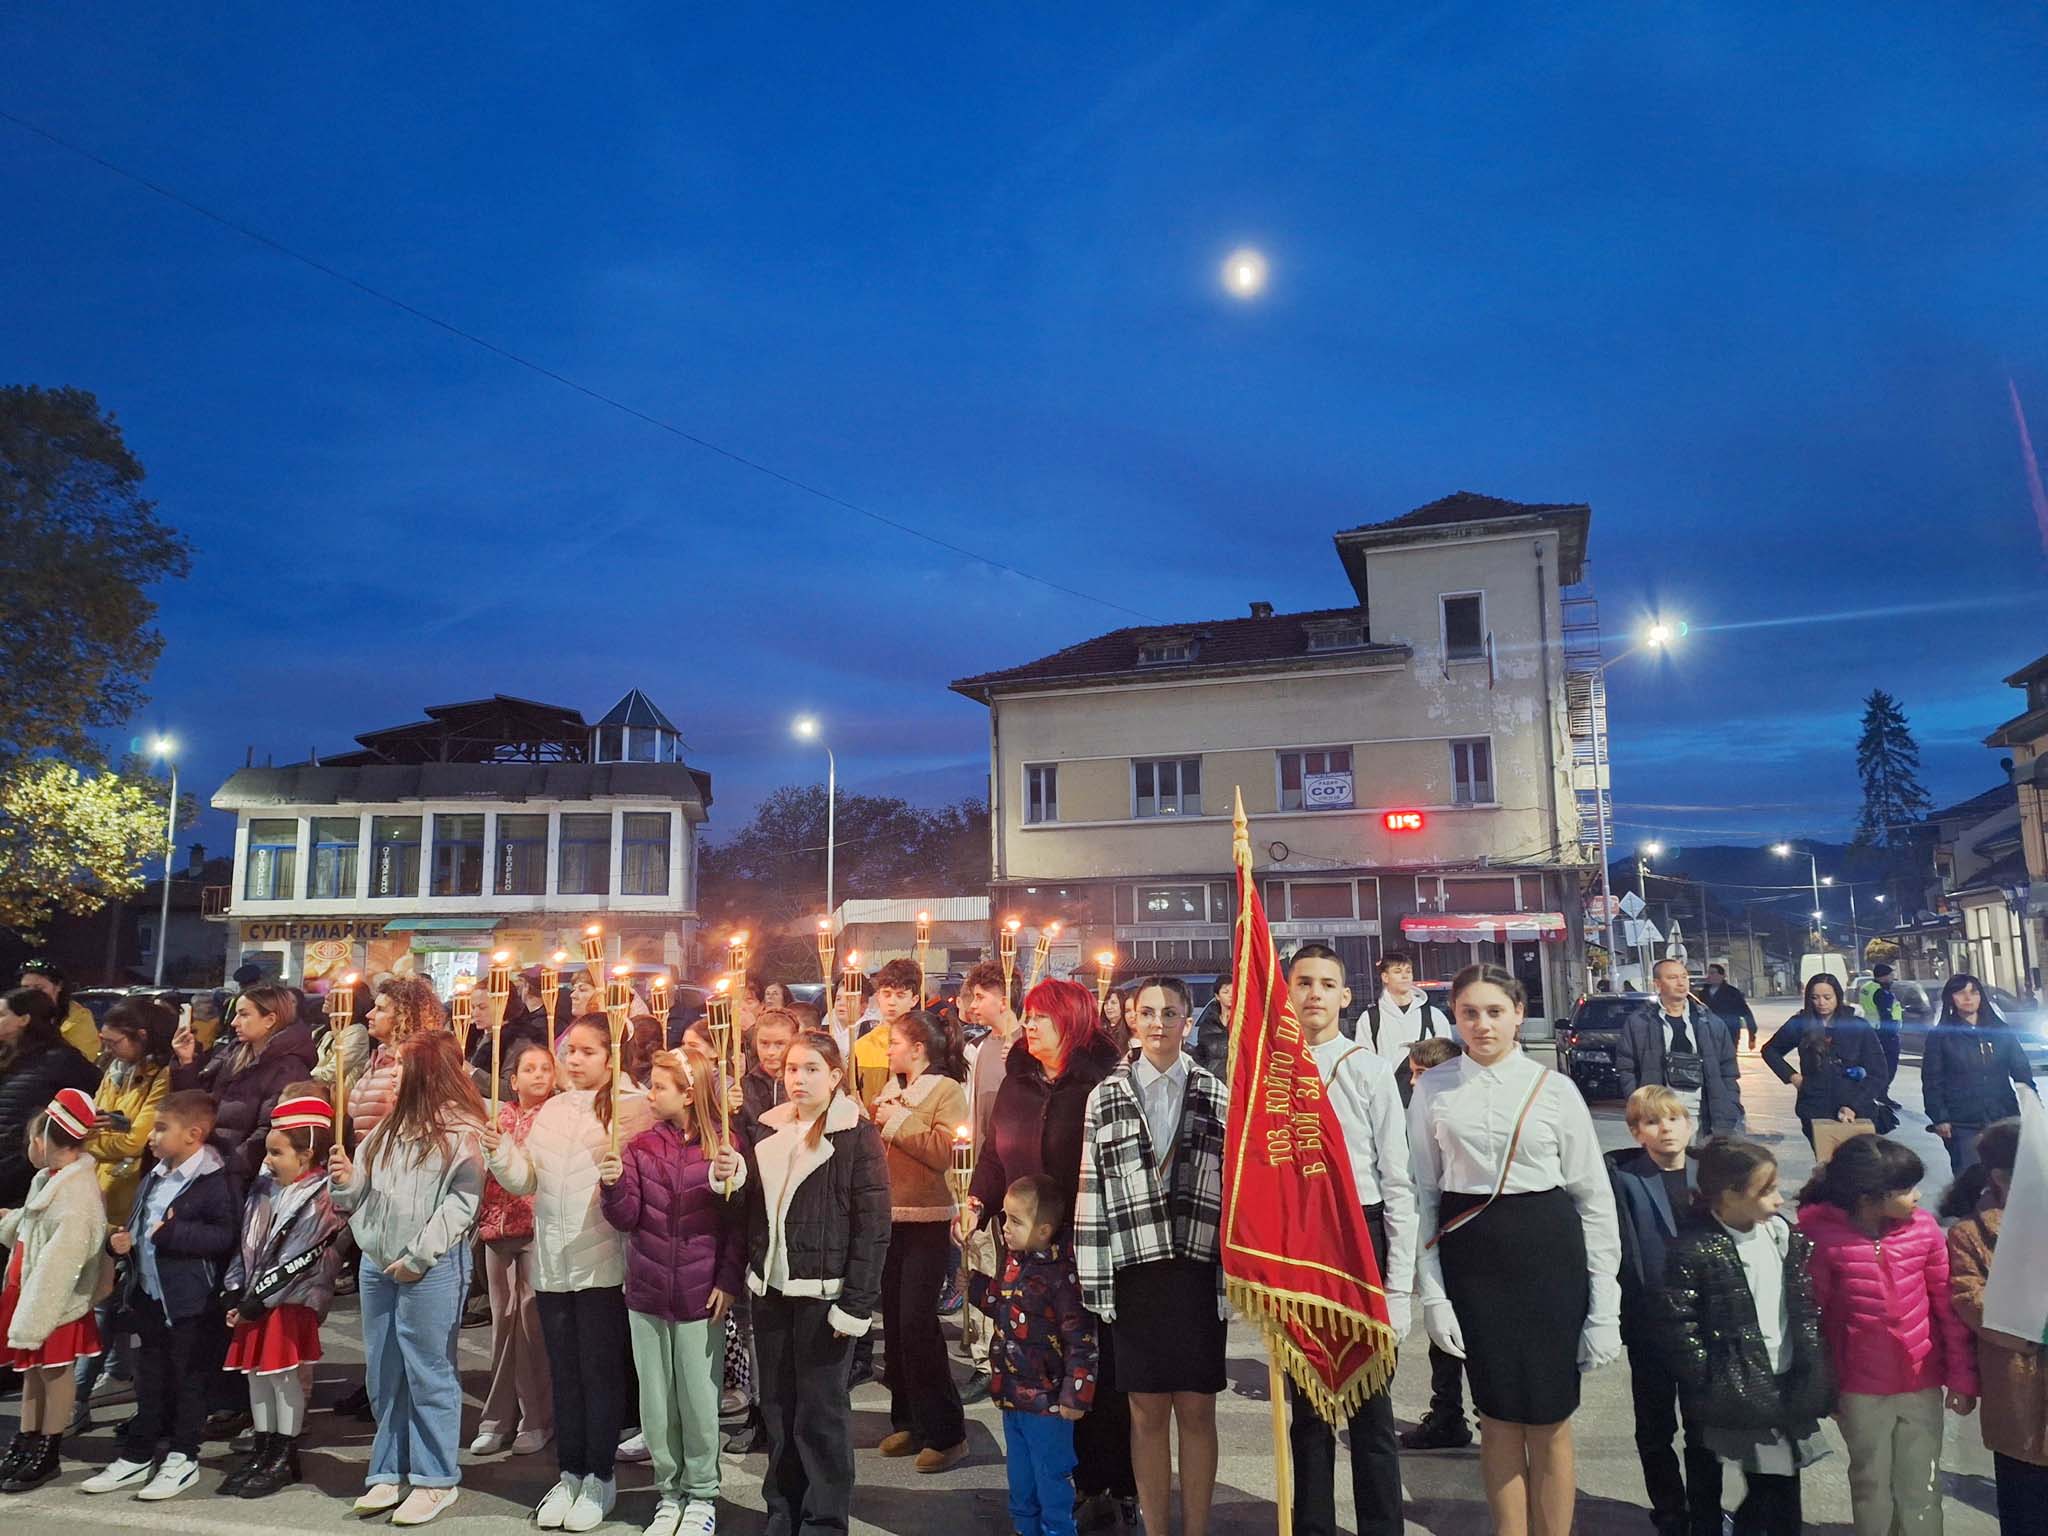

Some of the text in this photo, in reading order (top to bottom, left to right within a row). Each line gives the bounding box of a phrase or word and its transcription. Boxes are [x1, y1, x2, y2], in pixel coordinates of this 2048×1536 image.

[1311, 785, 1347, 796] СОТ
[380, 846, 390, 893] ОТВОРЕНО
[504, 843, 513, 891] ОТВОРЕНО
[1263, 1050, 1295, 1116] КОЙТО
[1296, 1075, 1321, 1101] ЗА
[1290, 1112, 1323, 1151] БОЙ
[1302, 1161, 1327, 1178] В
